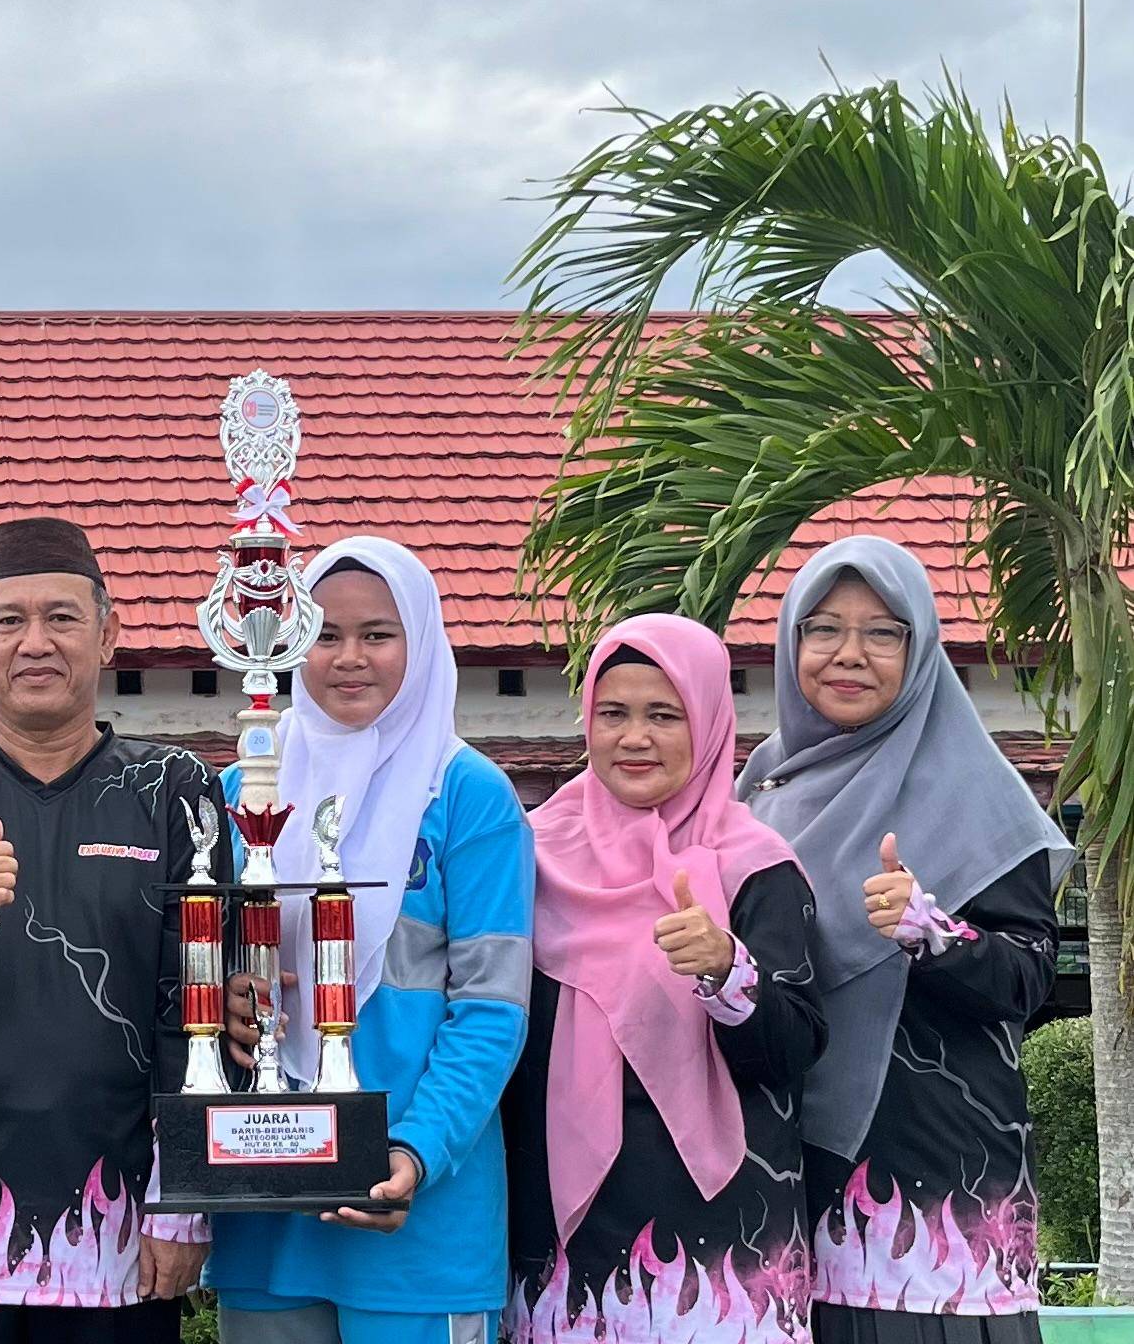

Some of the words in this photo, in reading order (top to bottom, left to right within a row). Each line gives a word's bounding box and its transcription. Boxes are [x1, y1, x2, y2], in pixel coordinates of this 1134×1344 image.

[78, 844, 128, 857] EXCLUSIVE
[127, 846, 159, 861] JERSEY
[244, 1113, 290, 1124] JUARA
[295, 1113, 298, 1124] I
